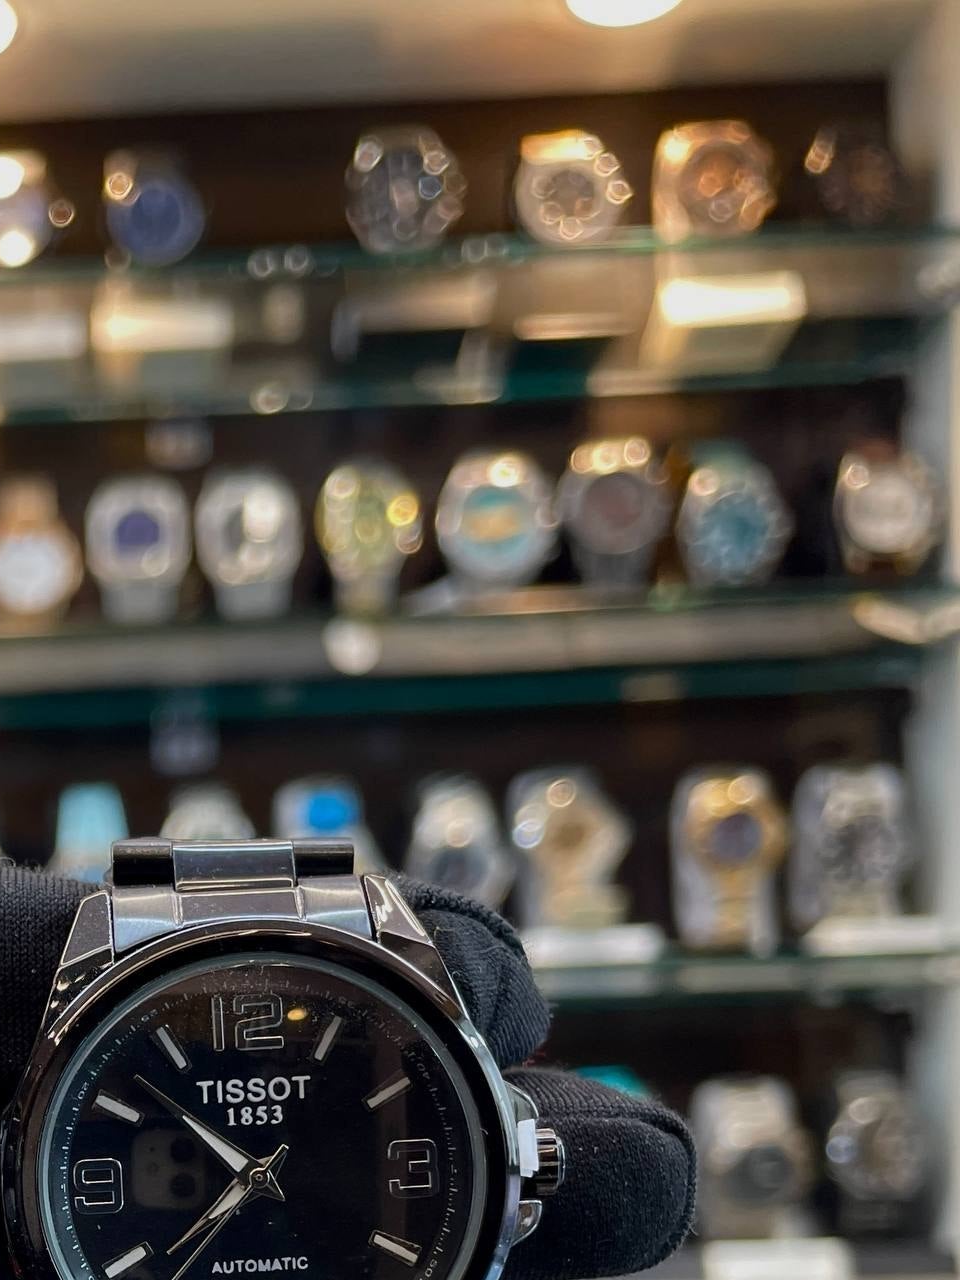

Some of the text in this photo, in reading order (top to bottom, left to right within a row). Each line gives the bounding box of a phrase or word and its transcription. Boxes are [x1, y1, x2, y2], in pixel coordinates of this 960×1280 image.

[210, 993, 285, 1052] 12
[196, 1075, 311, 1104] TISSOT
[226, 1104, 284, 1127] 1853
[73, 1157, 124, 1215] 9
[387, 1138, 440, 1199] 3
[211, 1256, 309, 1274] AUTOMATIC
